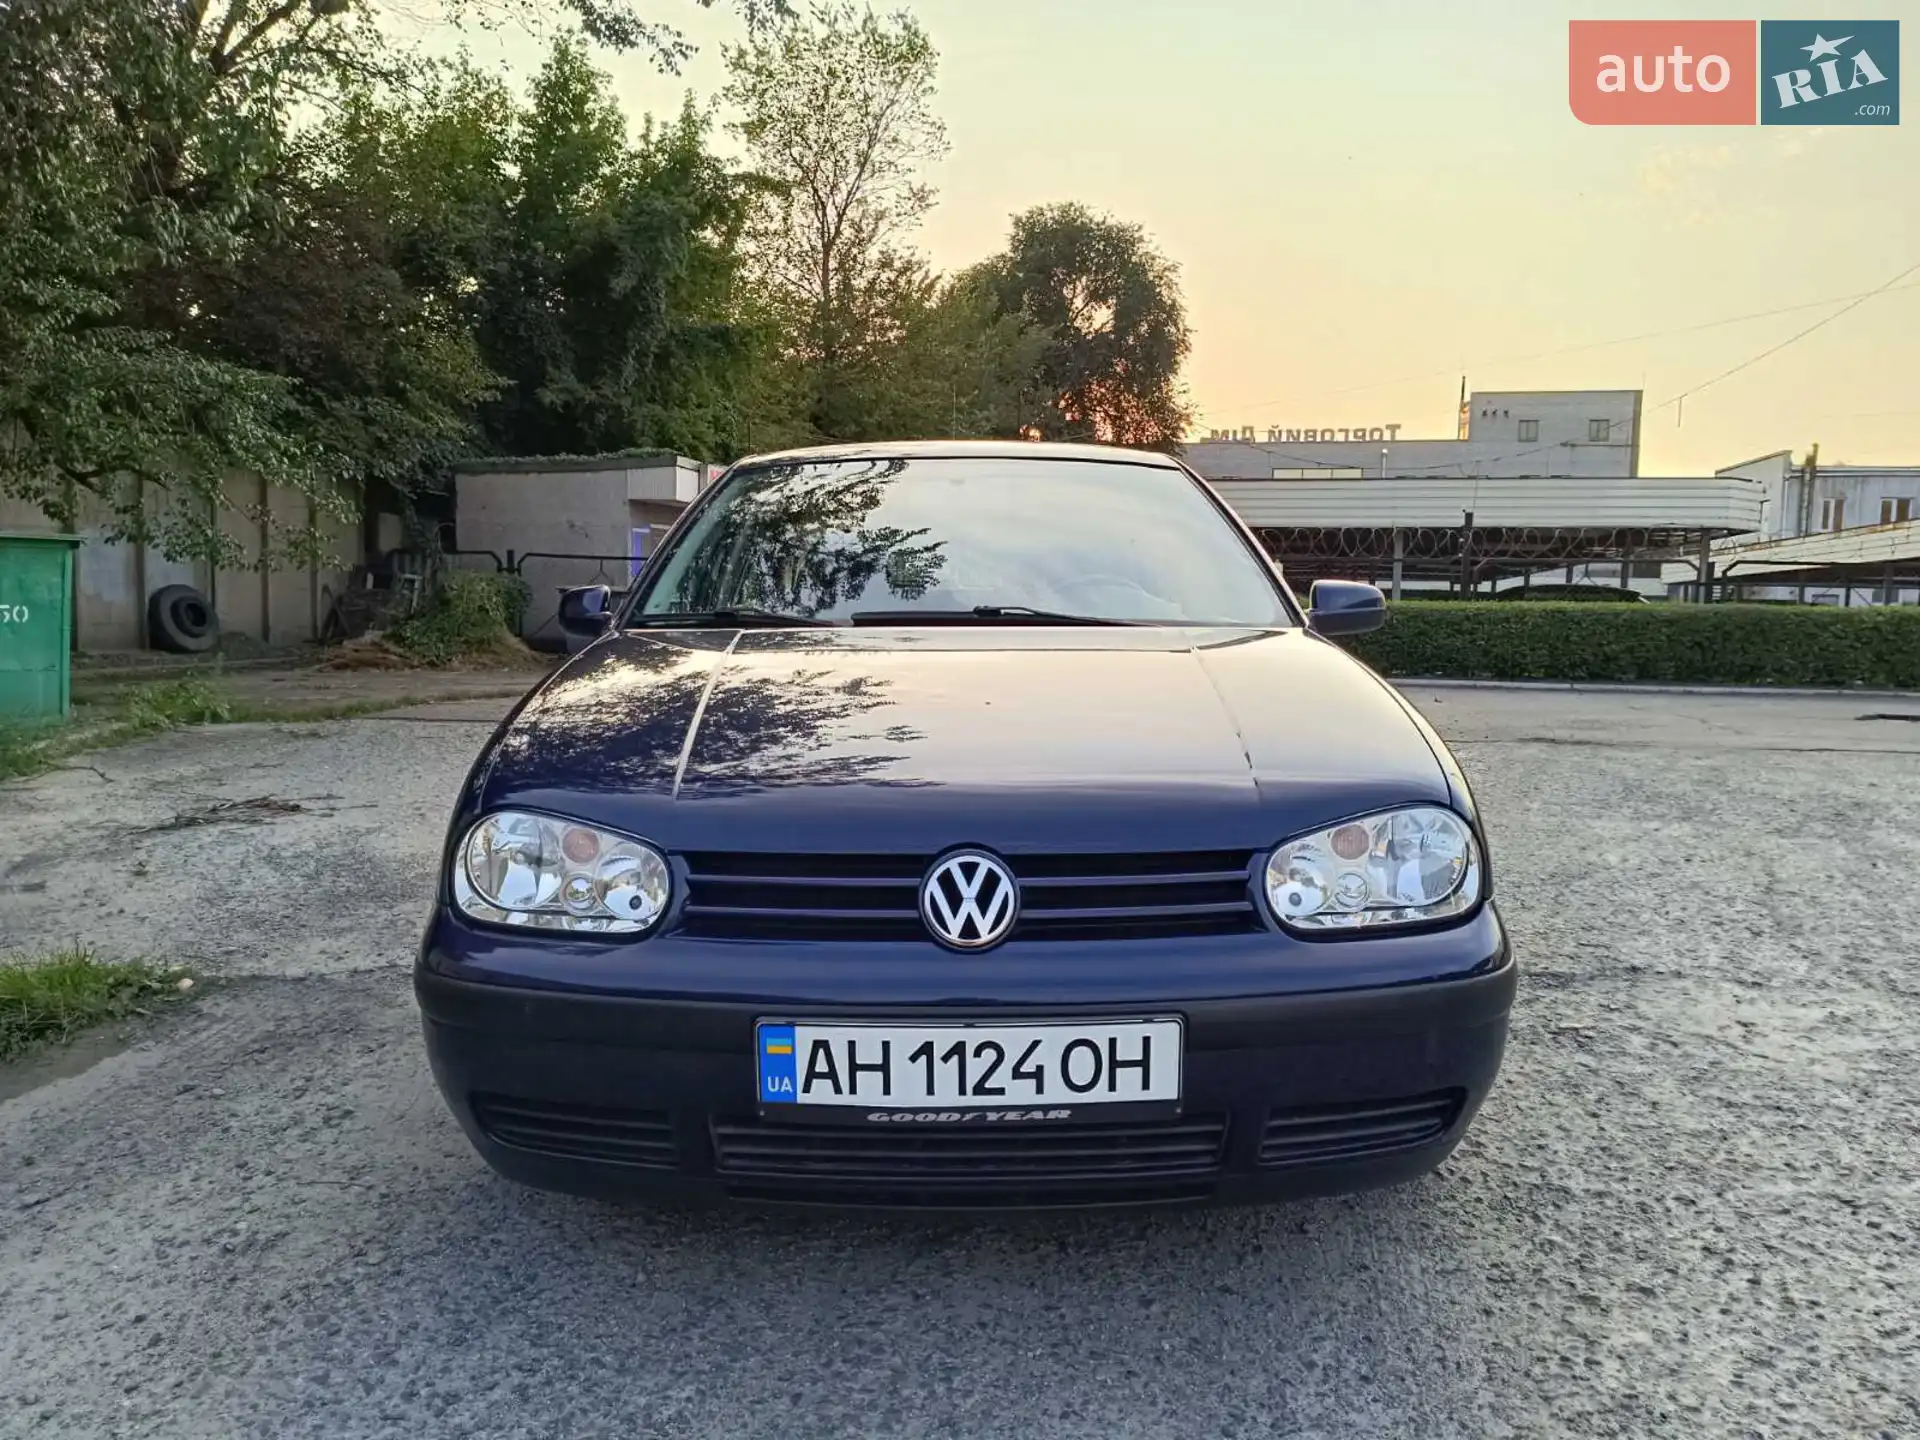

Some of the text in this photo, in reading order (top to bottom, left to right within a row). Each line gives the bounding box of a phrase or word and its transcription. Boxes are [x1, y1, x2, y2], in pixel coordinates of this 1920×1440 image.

[767, 1076, 794, 1094] UA
[800, 1035, 1153, 1097] AH 1124 OH
